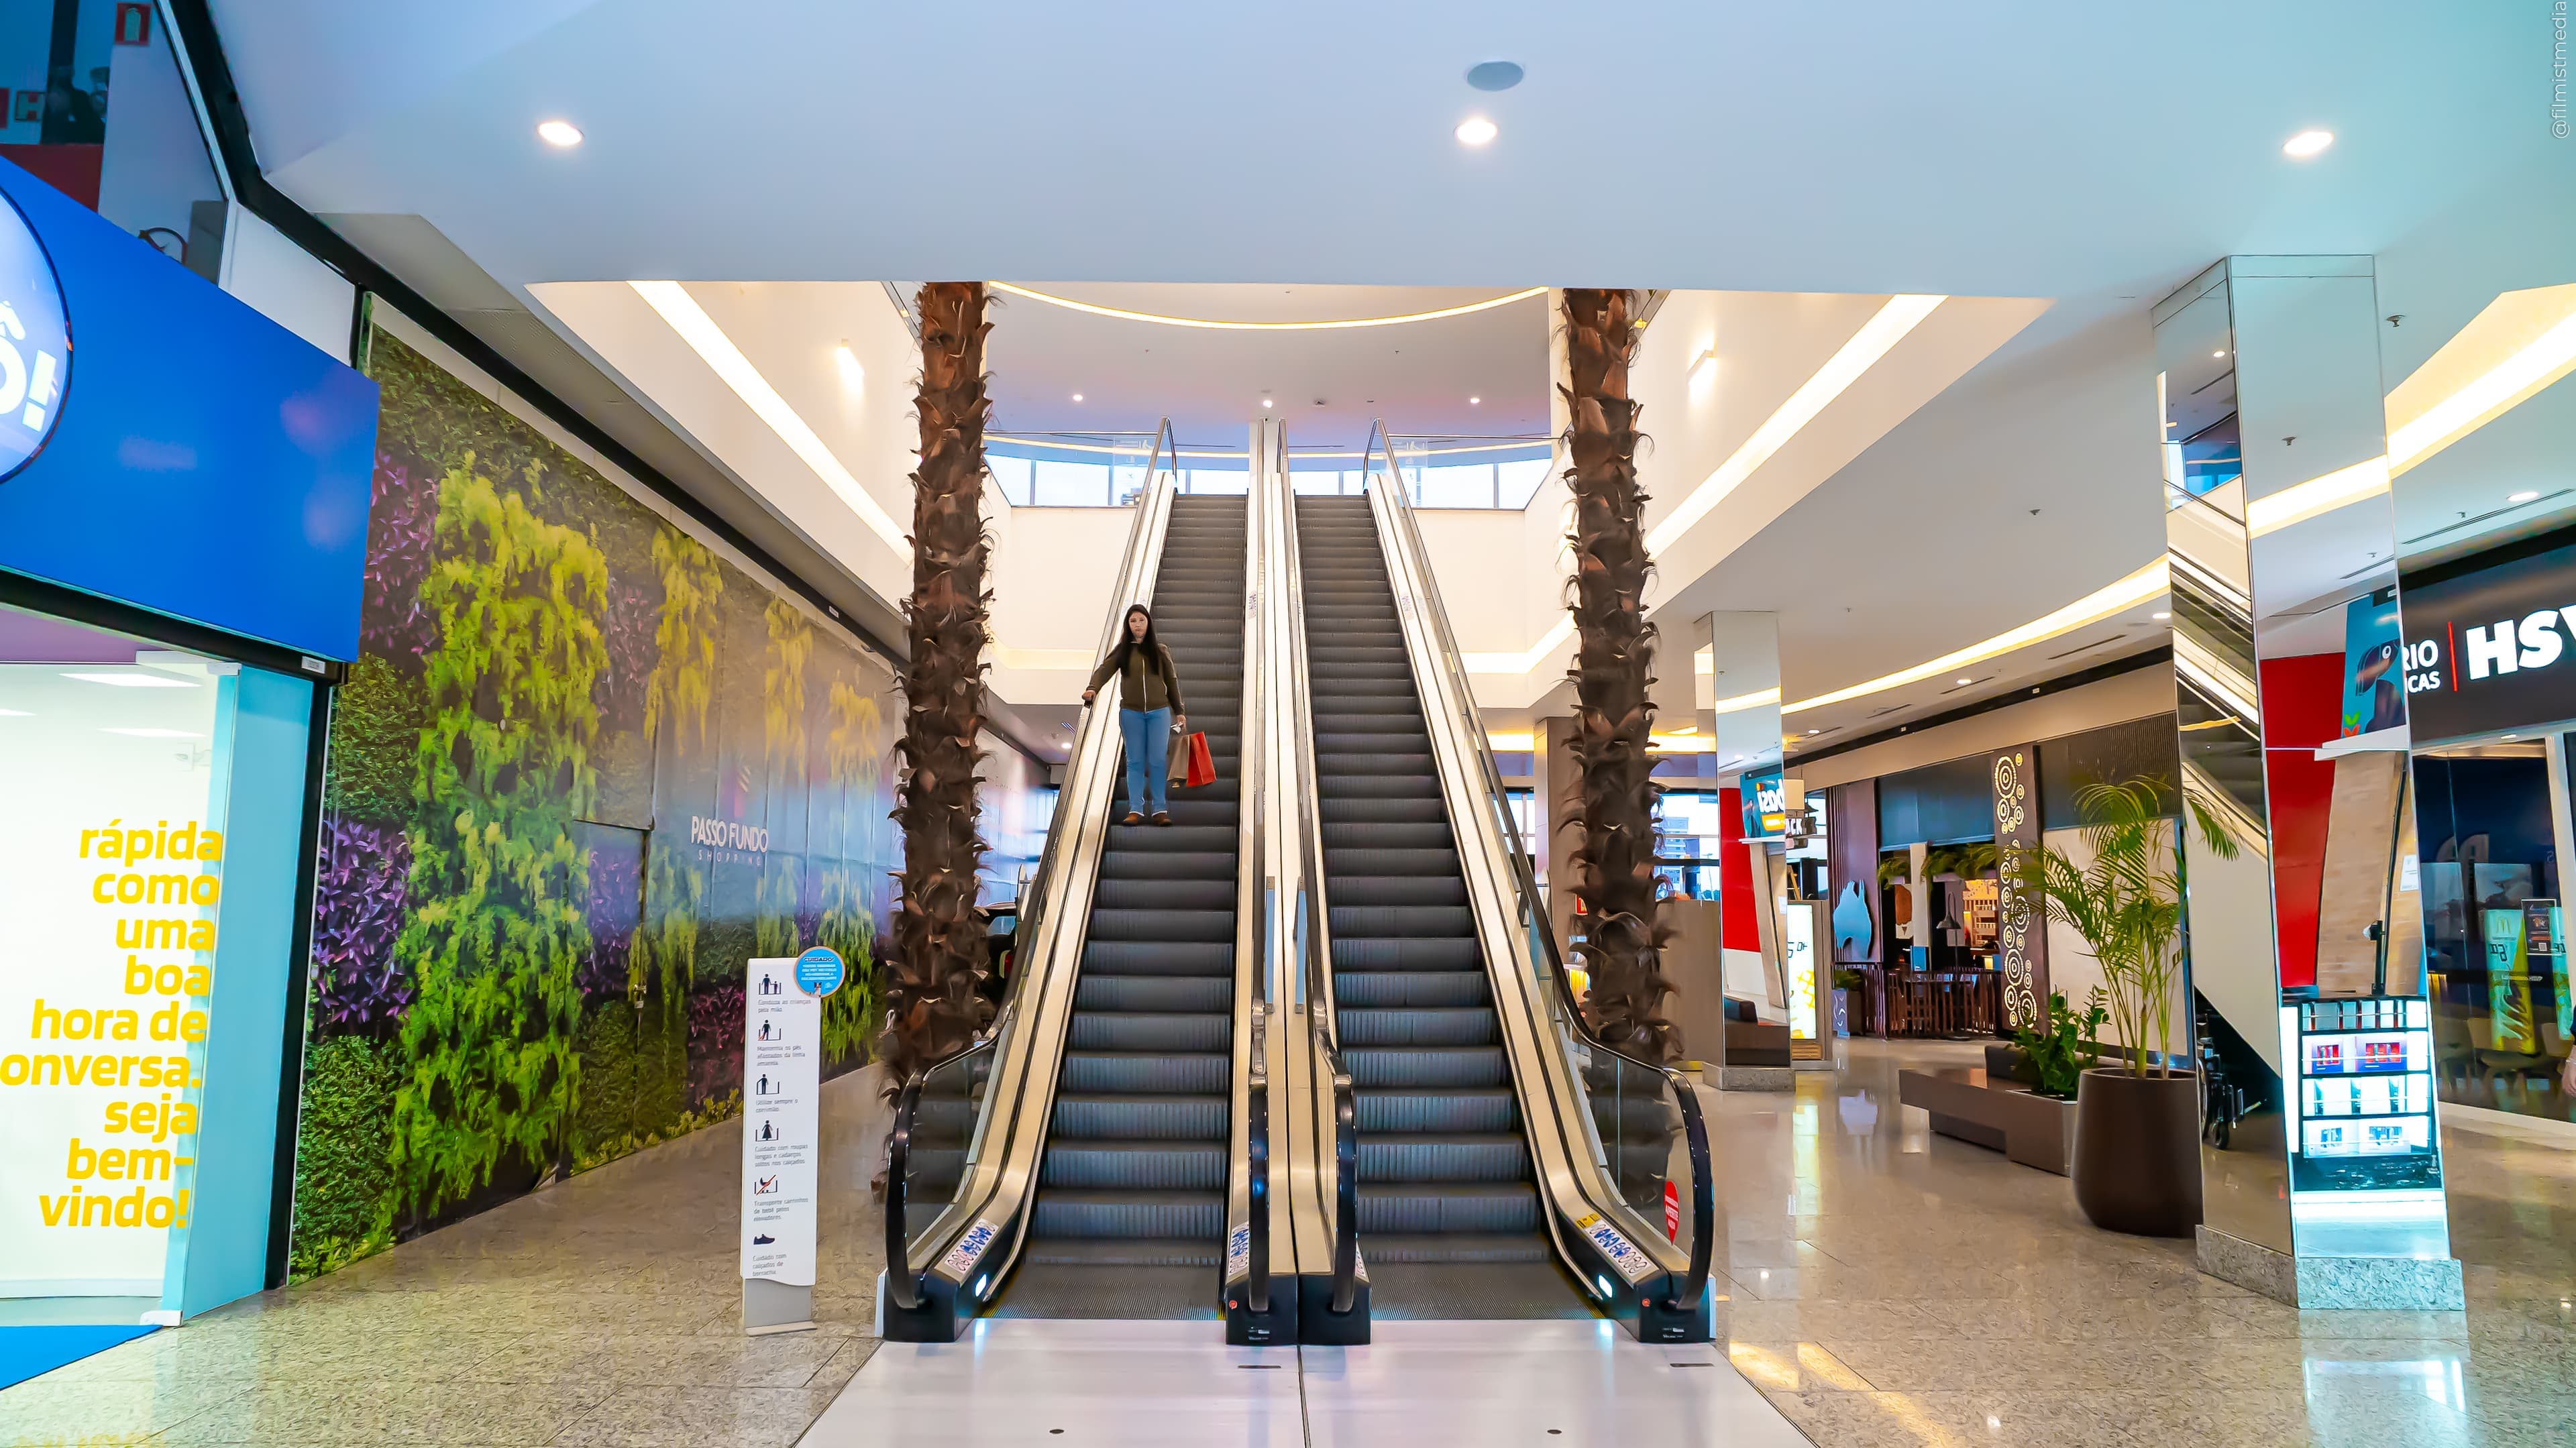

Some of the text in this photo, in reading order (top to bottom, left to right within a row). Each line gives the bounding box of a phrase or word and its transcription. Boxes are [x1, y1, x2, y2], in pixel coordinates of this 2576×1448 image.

[79, 818, 223, 868] rápida
[691, 816, 768, 853] PASSO FUNDO
[698, 850, 762, 867] SHOPPING
[93, 873, 220, 906] como
[115, 919, 215, 952] uma
[124, 954, 211, 997] boa
[30, 998, 207, 1043] hora de
[0, 1054, 202, 1089] onversa.
[103, 1093, 198, 1144] seja
[66, 1137, 194, 1181] bem-
[38, 1184, 190, 1229] vindo!
